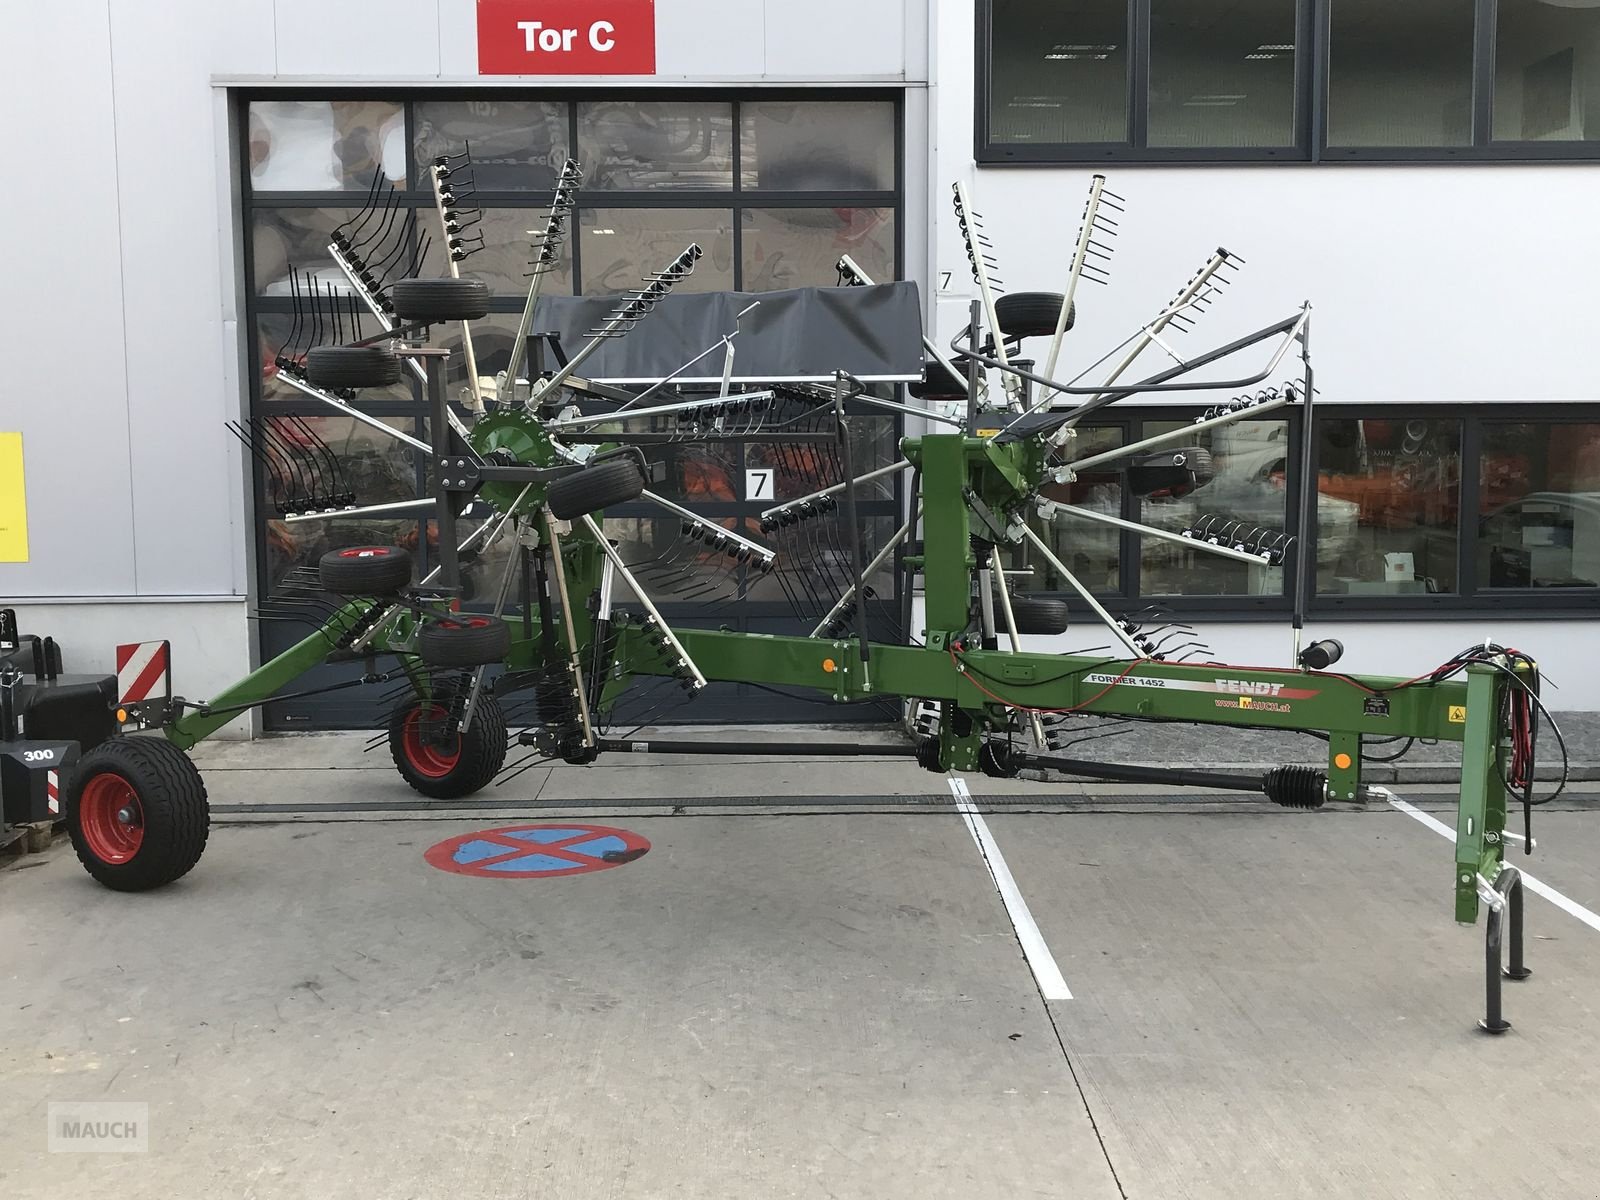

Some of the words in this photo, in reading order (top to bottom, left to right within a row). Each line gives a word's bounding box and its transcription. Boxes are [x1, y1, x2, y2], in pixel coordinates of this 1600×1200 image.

[517, 21, 578, 52] Tor
[588, 20, 615, 52] C
[941, 271, 952, 290] 7
[751, 473, 767, 497] 7
[1091, 675, 1137, 685] FORMER
[1139, 678, 1165, 687] 1452
[1215, 679, 1285, 696] FENDT
[1215, 699, 1291, 713] www.MAUCH.at
[23, 749, 54, 761] 300
